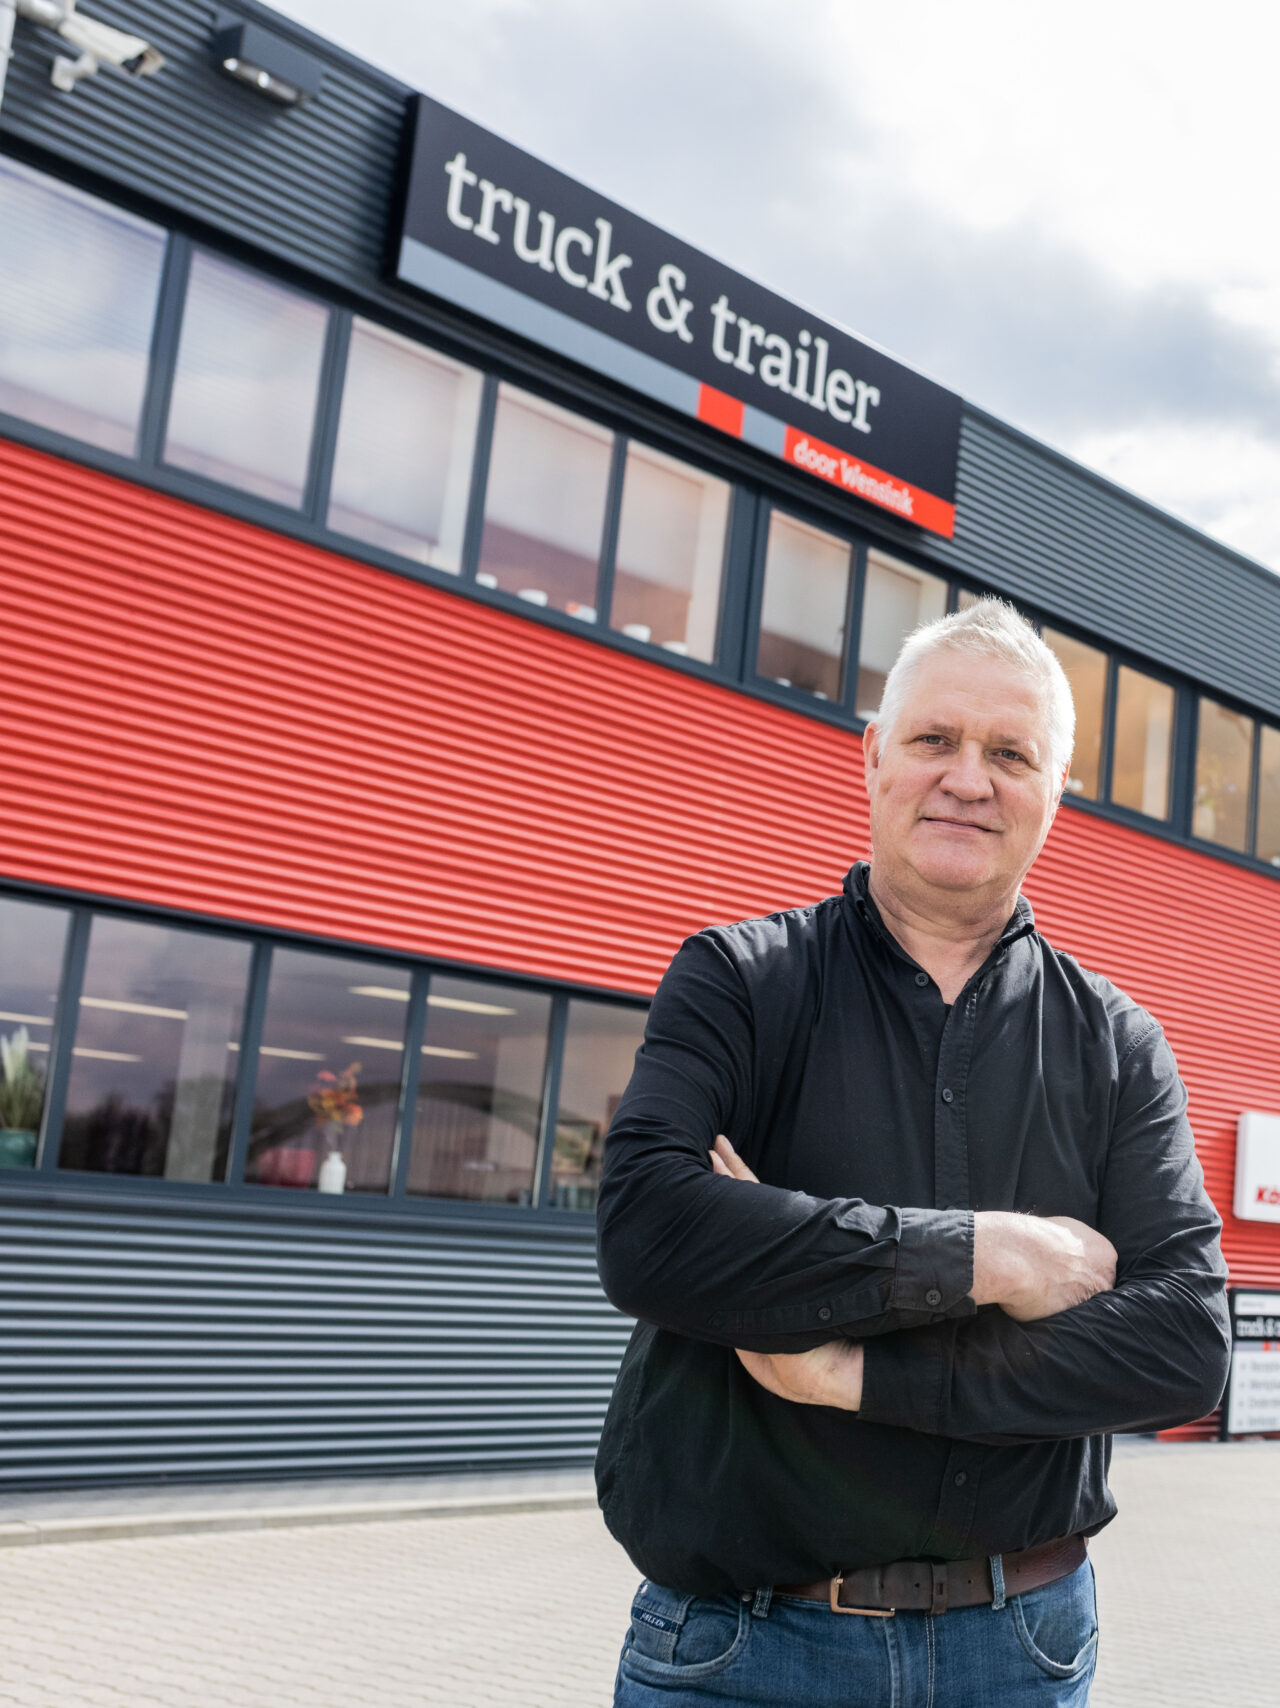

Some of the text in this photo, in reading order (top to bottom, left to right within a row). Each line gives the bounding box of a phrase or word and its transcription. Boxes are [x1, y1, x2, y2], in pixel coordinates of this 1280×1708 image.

[445, 153, 880, 433] truck & trailer
[793, 438, 914, 516] door Wensink
